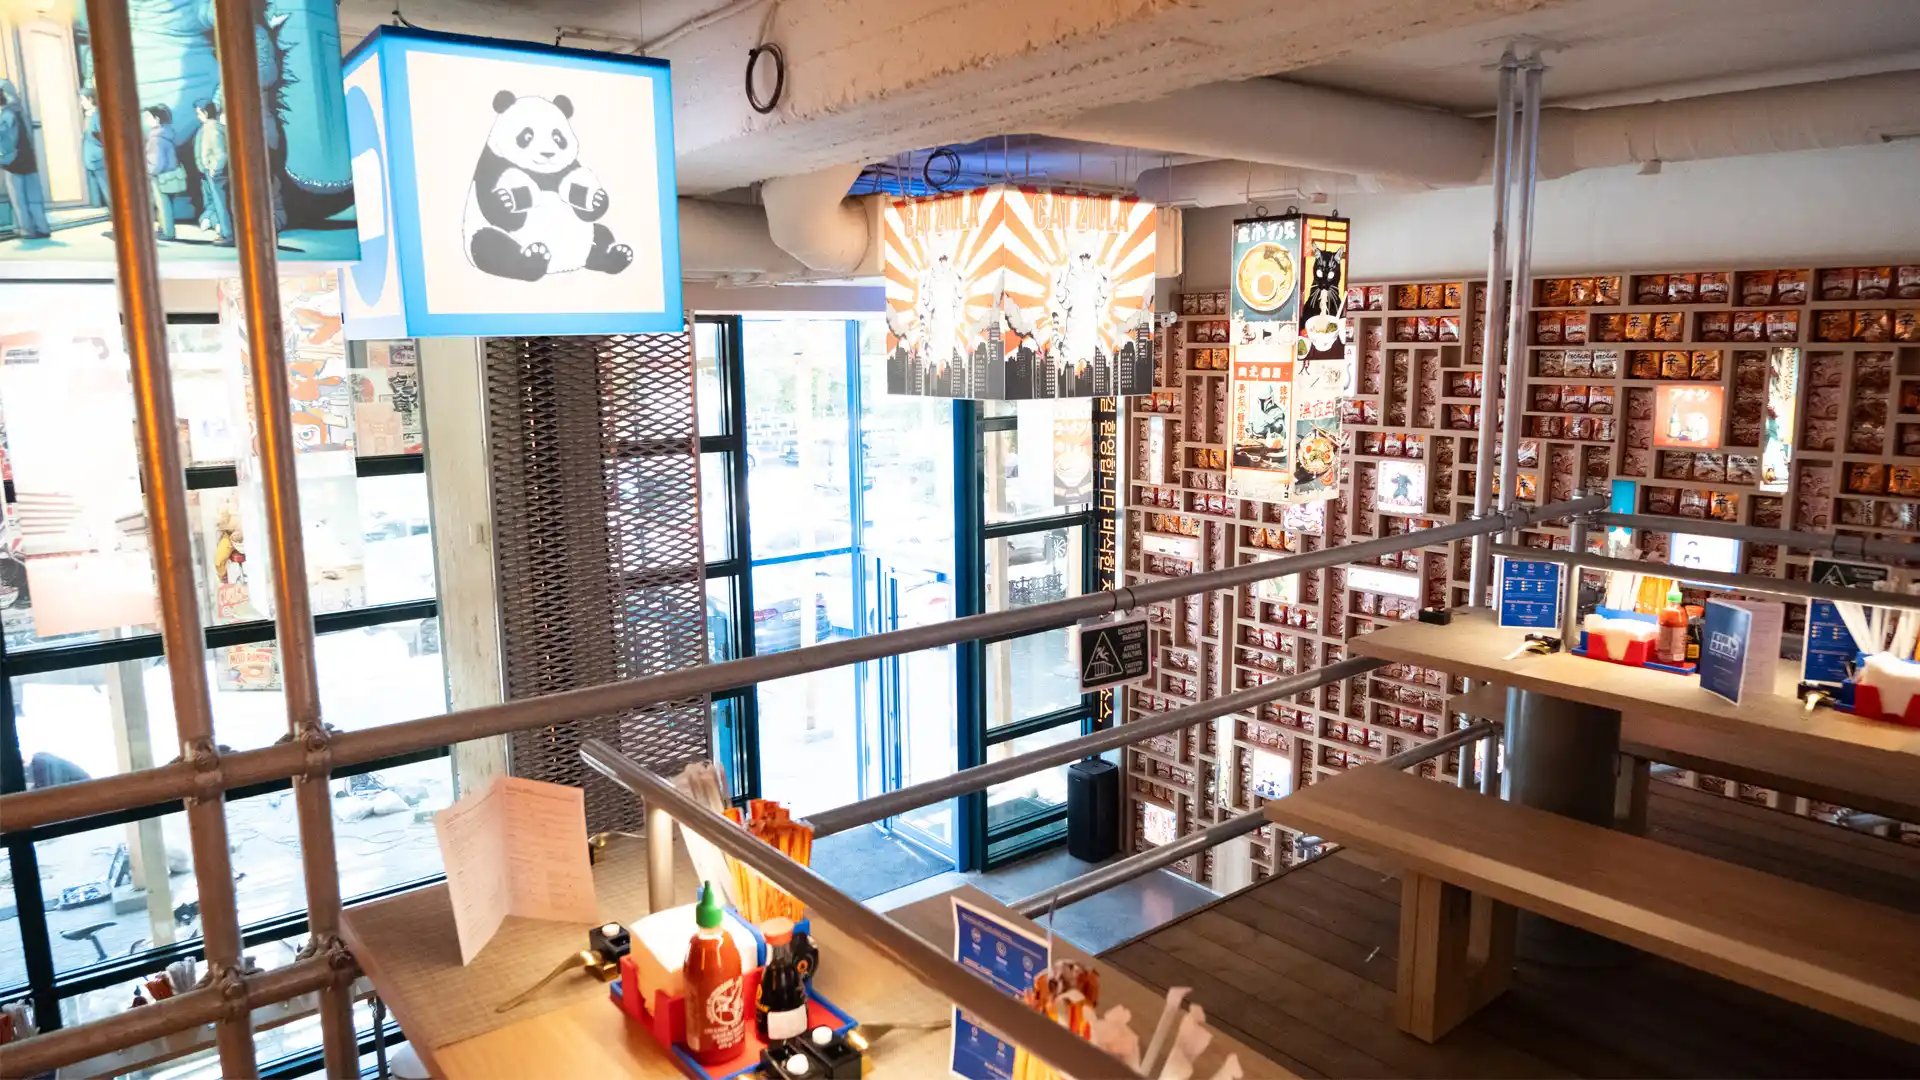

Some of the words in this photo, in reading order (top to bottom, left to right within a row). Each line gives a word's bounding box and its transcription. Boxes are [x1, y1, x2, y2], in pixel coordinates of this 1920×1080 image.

[903, 197, 980, 238] CATZILLA
[1032, 194, 1129, 233] CATZILLA
[1660, 315, 1673, 332] 辛
[1665, 353, 1679, 370] 辛
[1696, 353, 1708, 370] 辛
[1100, 396, 1116, 413] 걸
[1099, 419, 1116, 513] 환영합니다
[1099, 518, 1116, 574] 바삭한
